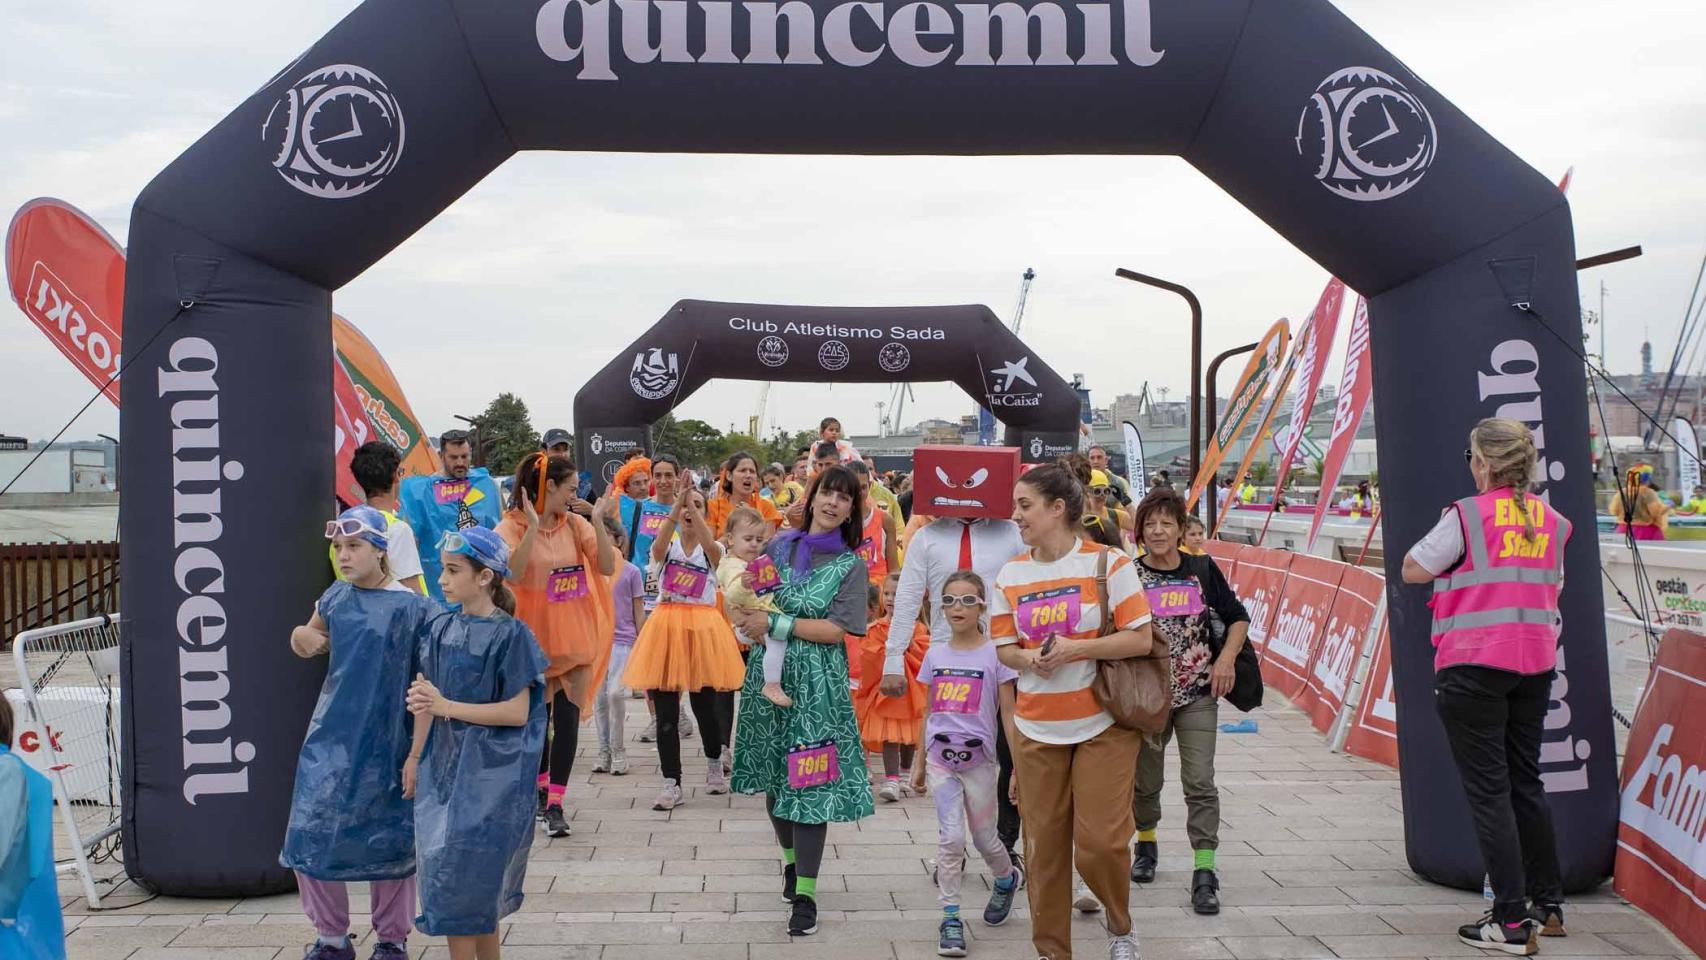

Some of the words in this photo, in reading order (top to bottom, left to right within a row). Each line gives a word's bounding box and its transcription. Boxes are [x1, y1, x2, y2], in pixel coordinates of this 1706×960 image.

[536, 0, 1165, 80] quincemil
[728, 317, 778, 333] Club
[783, 321, 883, 339] Atletismo
[890, 326, 945, 340] Sada
[1002, 393, 1043, 406] Caixa"
[1499, 530, 1550, 558] Staff
[158, 336, 257, 806] quincemil
[1656, 576, 1688, 595] gestán
[1031, 601, 1068, 628] 7913
[936, 682, 971, 702] 7912
